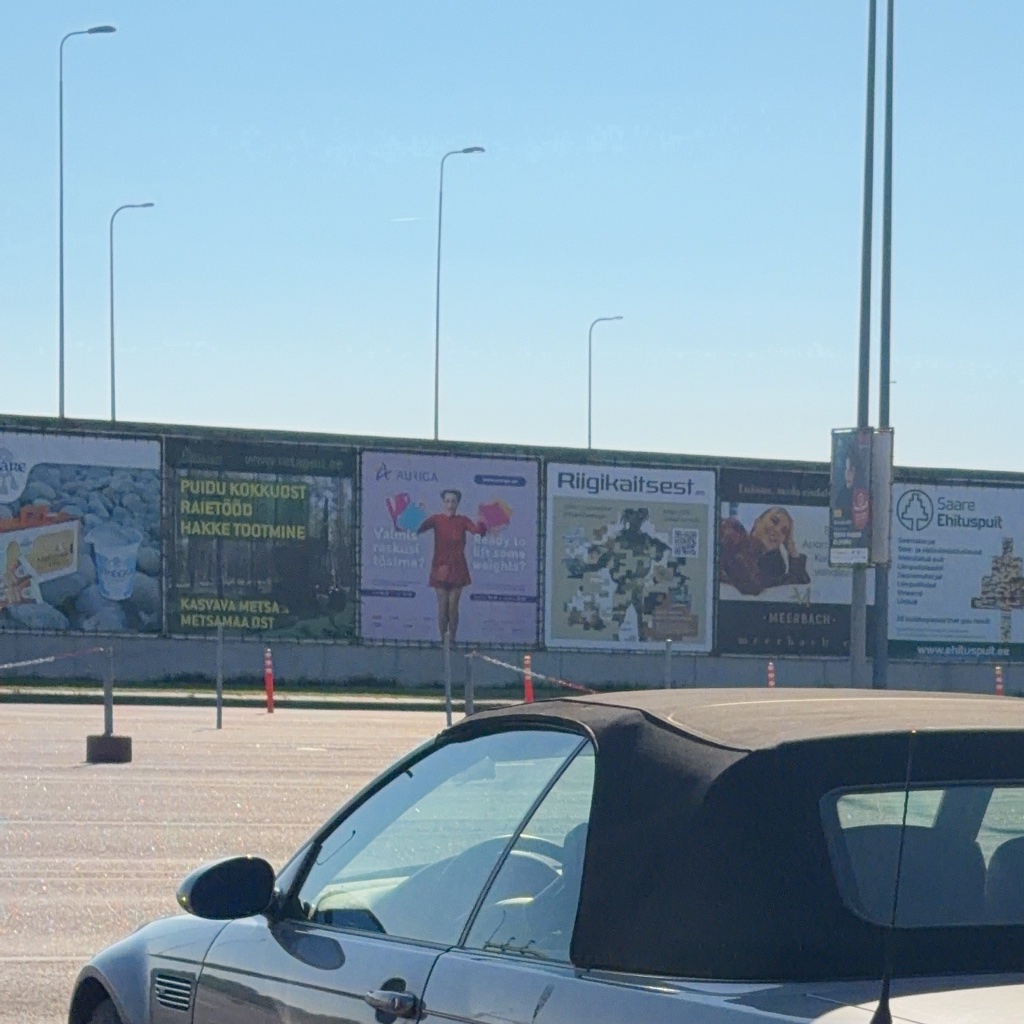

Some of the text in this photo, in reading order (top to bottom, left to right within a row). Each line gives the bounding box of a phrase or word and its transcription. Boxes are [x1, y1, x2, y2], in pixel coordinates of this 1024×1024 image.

[180, 479, 307, 500] PUIDU KOKKUOST
[557, 471, 695, 495] Riigikaitsest
[180, 499, 253, 517] RAIETÖÖD
[937, 497, 975, 512] Saare
[180, 521, 306, 540] HAKKE TOOTMINE
[937, 513, 1003, 531] Ehituspuit
[180, 597, 236, 612] KASVAVA
[239, 600, 280, 614] METSA
[180, 614, 276, 629] METSAMAA OST
[768, 612, 831, 625] MEERBACH
[917, 645, 1010, 657] www.ehituspuit.ee
